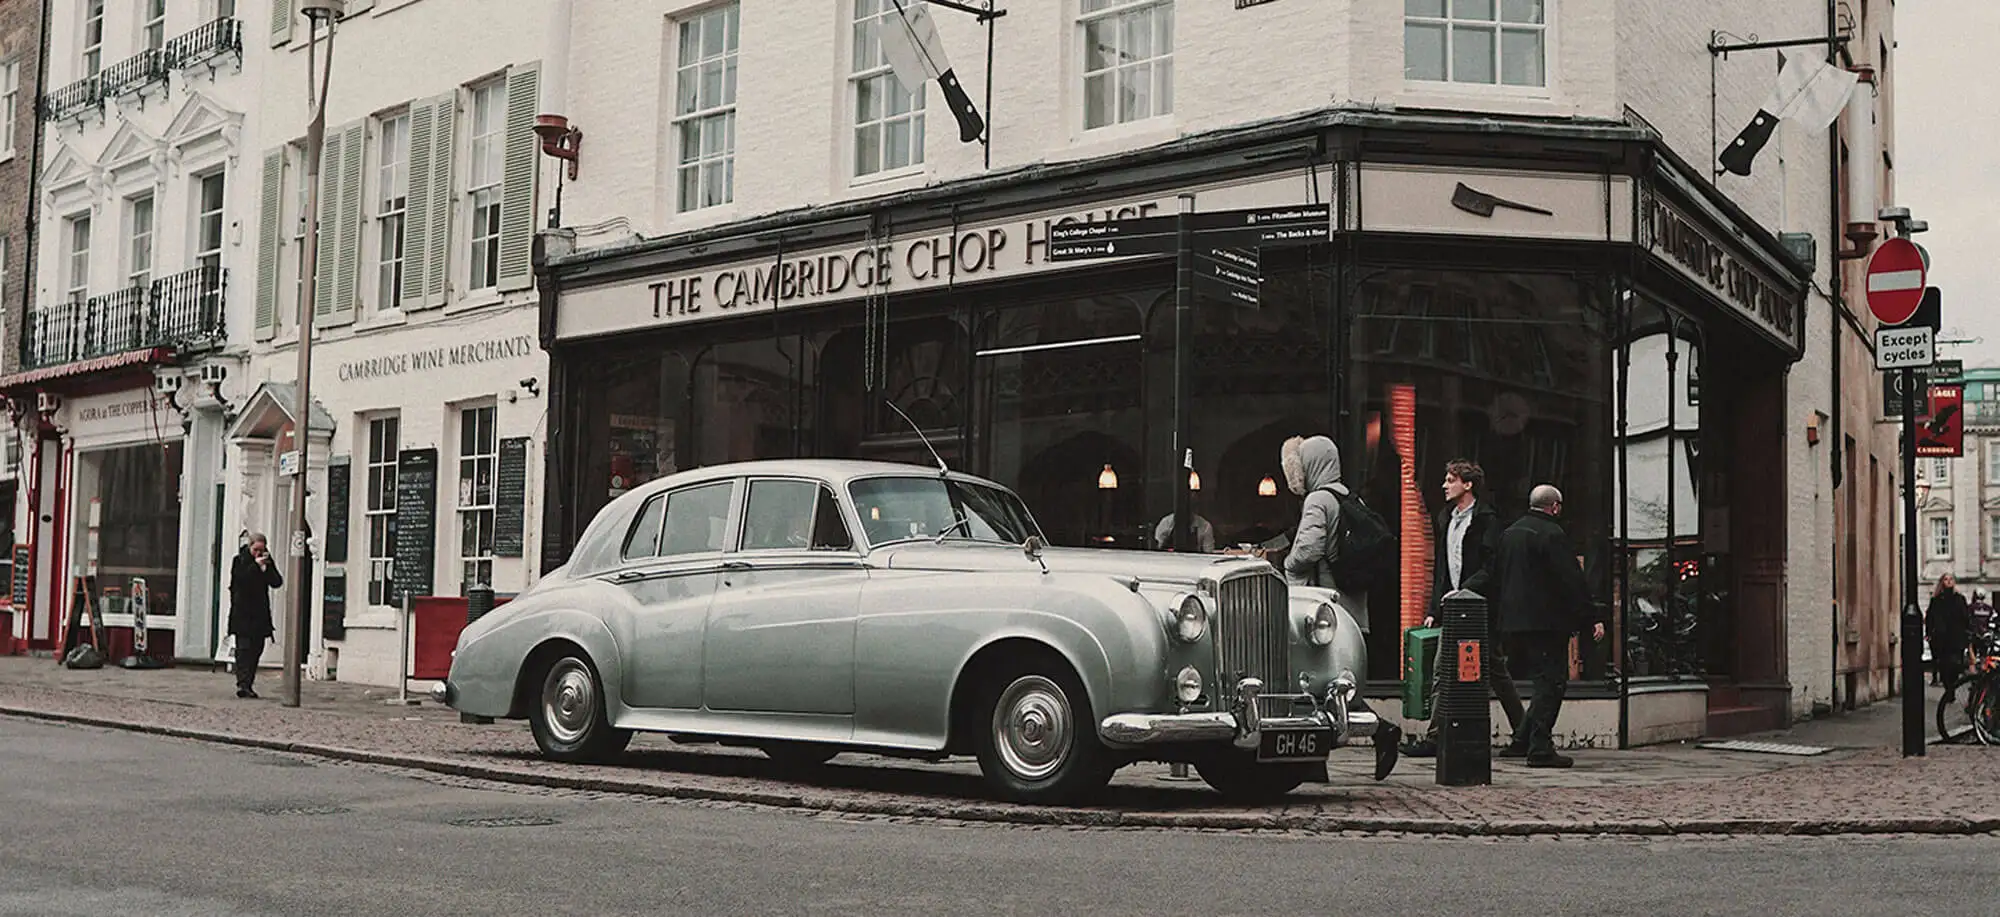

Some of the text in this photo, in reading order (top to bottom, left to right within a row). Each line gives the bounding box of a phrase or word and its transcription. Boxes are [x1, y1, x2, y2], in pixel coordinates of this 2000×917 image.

[1089, 226, 1106, 234] Chapel
[648, 276, 702, 318] THE
[714, 246, 893, 309] CAMBRIDGE
[907, 228, 1007, 280] CHOP
[1882, 333, 1928, 348] Except
[338, 335, 531, 382] CAMBRIDGE WINE MERCHANTS
[1884, 348, 1925, 362] cycles
[1276, 733, 1317, 755] GH 46
